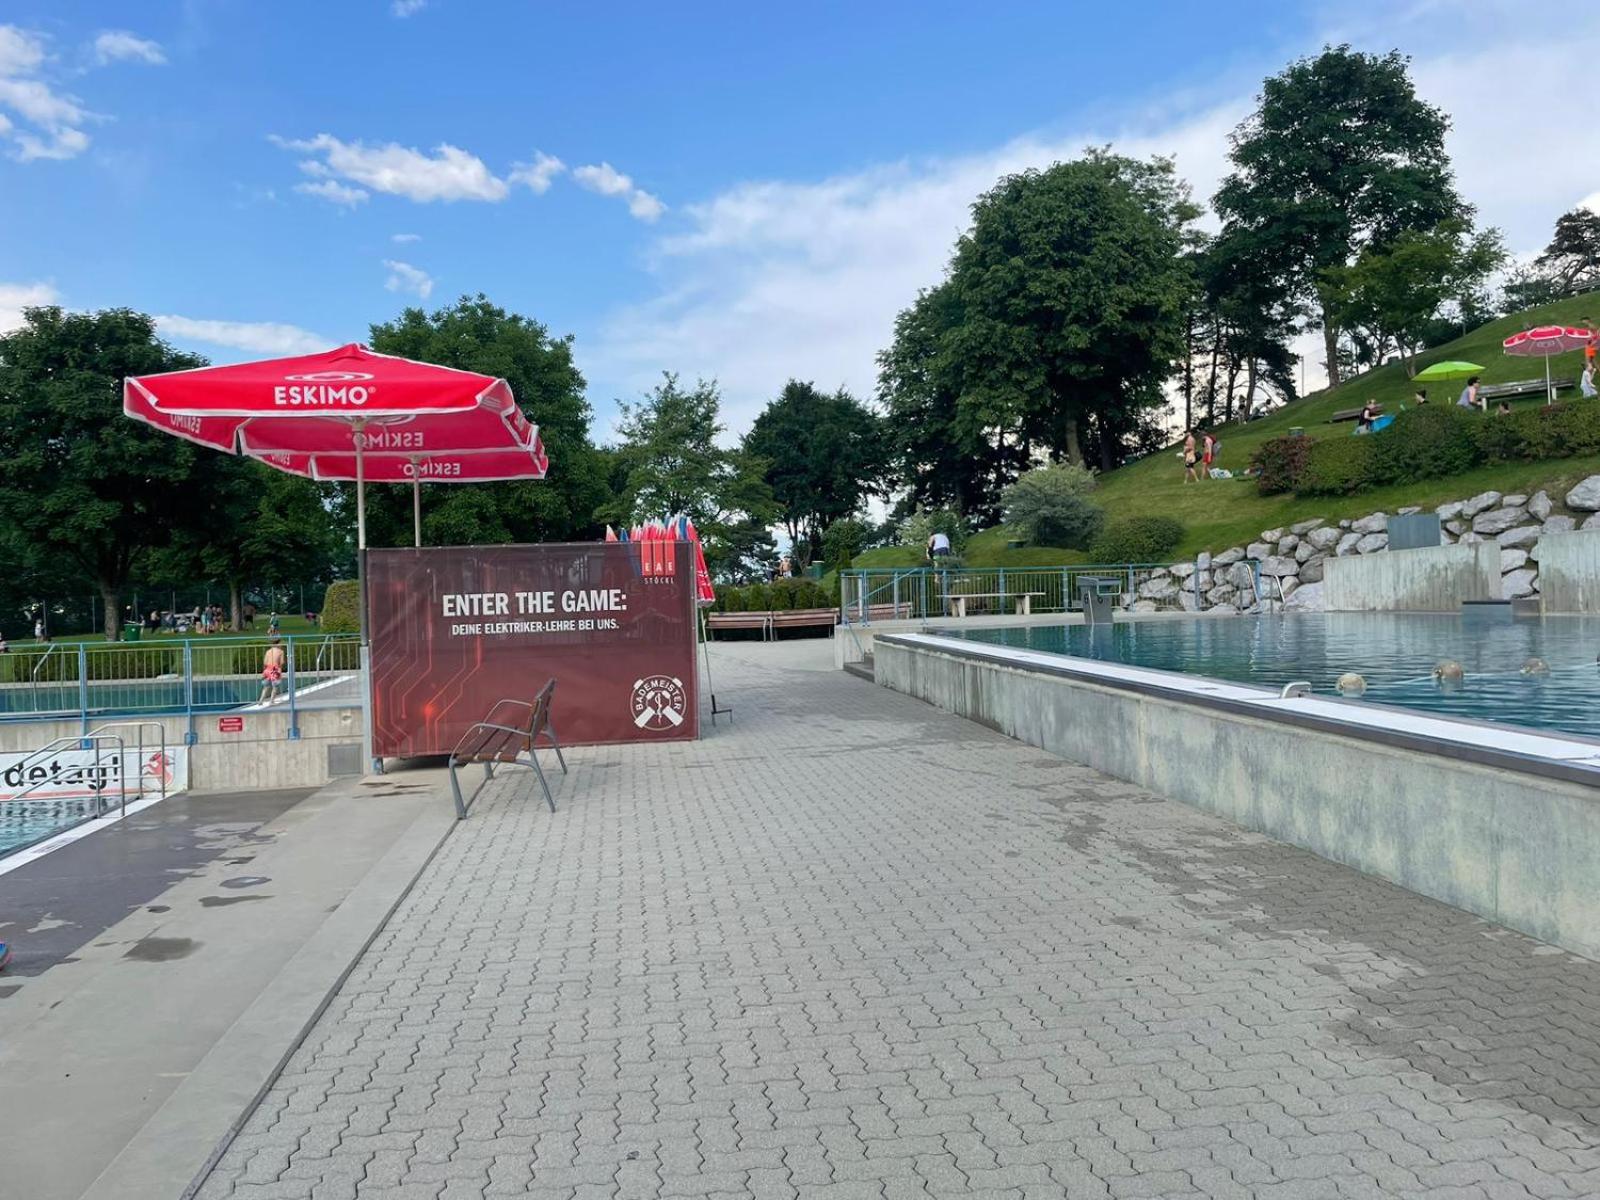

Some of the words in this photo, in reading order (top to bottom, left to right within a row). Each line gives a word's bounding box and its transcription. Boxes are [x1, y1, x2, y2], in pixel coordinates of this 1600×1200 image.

[442, 593, 510, 617] ENTER
[515, 591, 555, 614] THE
[561, 588, 627, 613] GAME:
[452, 624, 482, 636] DEINE
[484, 619, 576, 635] ELEKTRIKER-LEHRE
[578, 619, 594, 631] BEI
[598, 618, 620, 630] UNS.
[635, 679, 682, 711] BADEMEISTER
[3, 756, 119, 790] detag!
